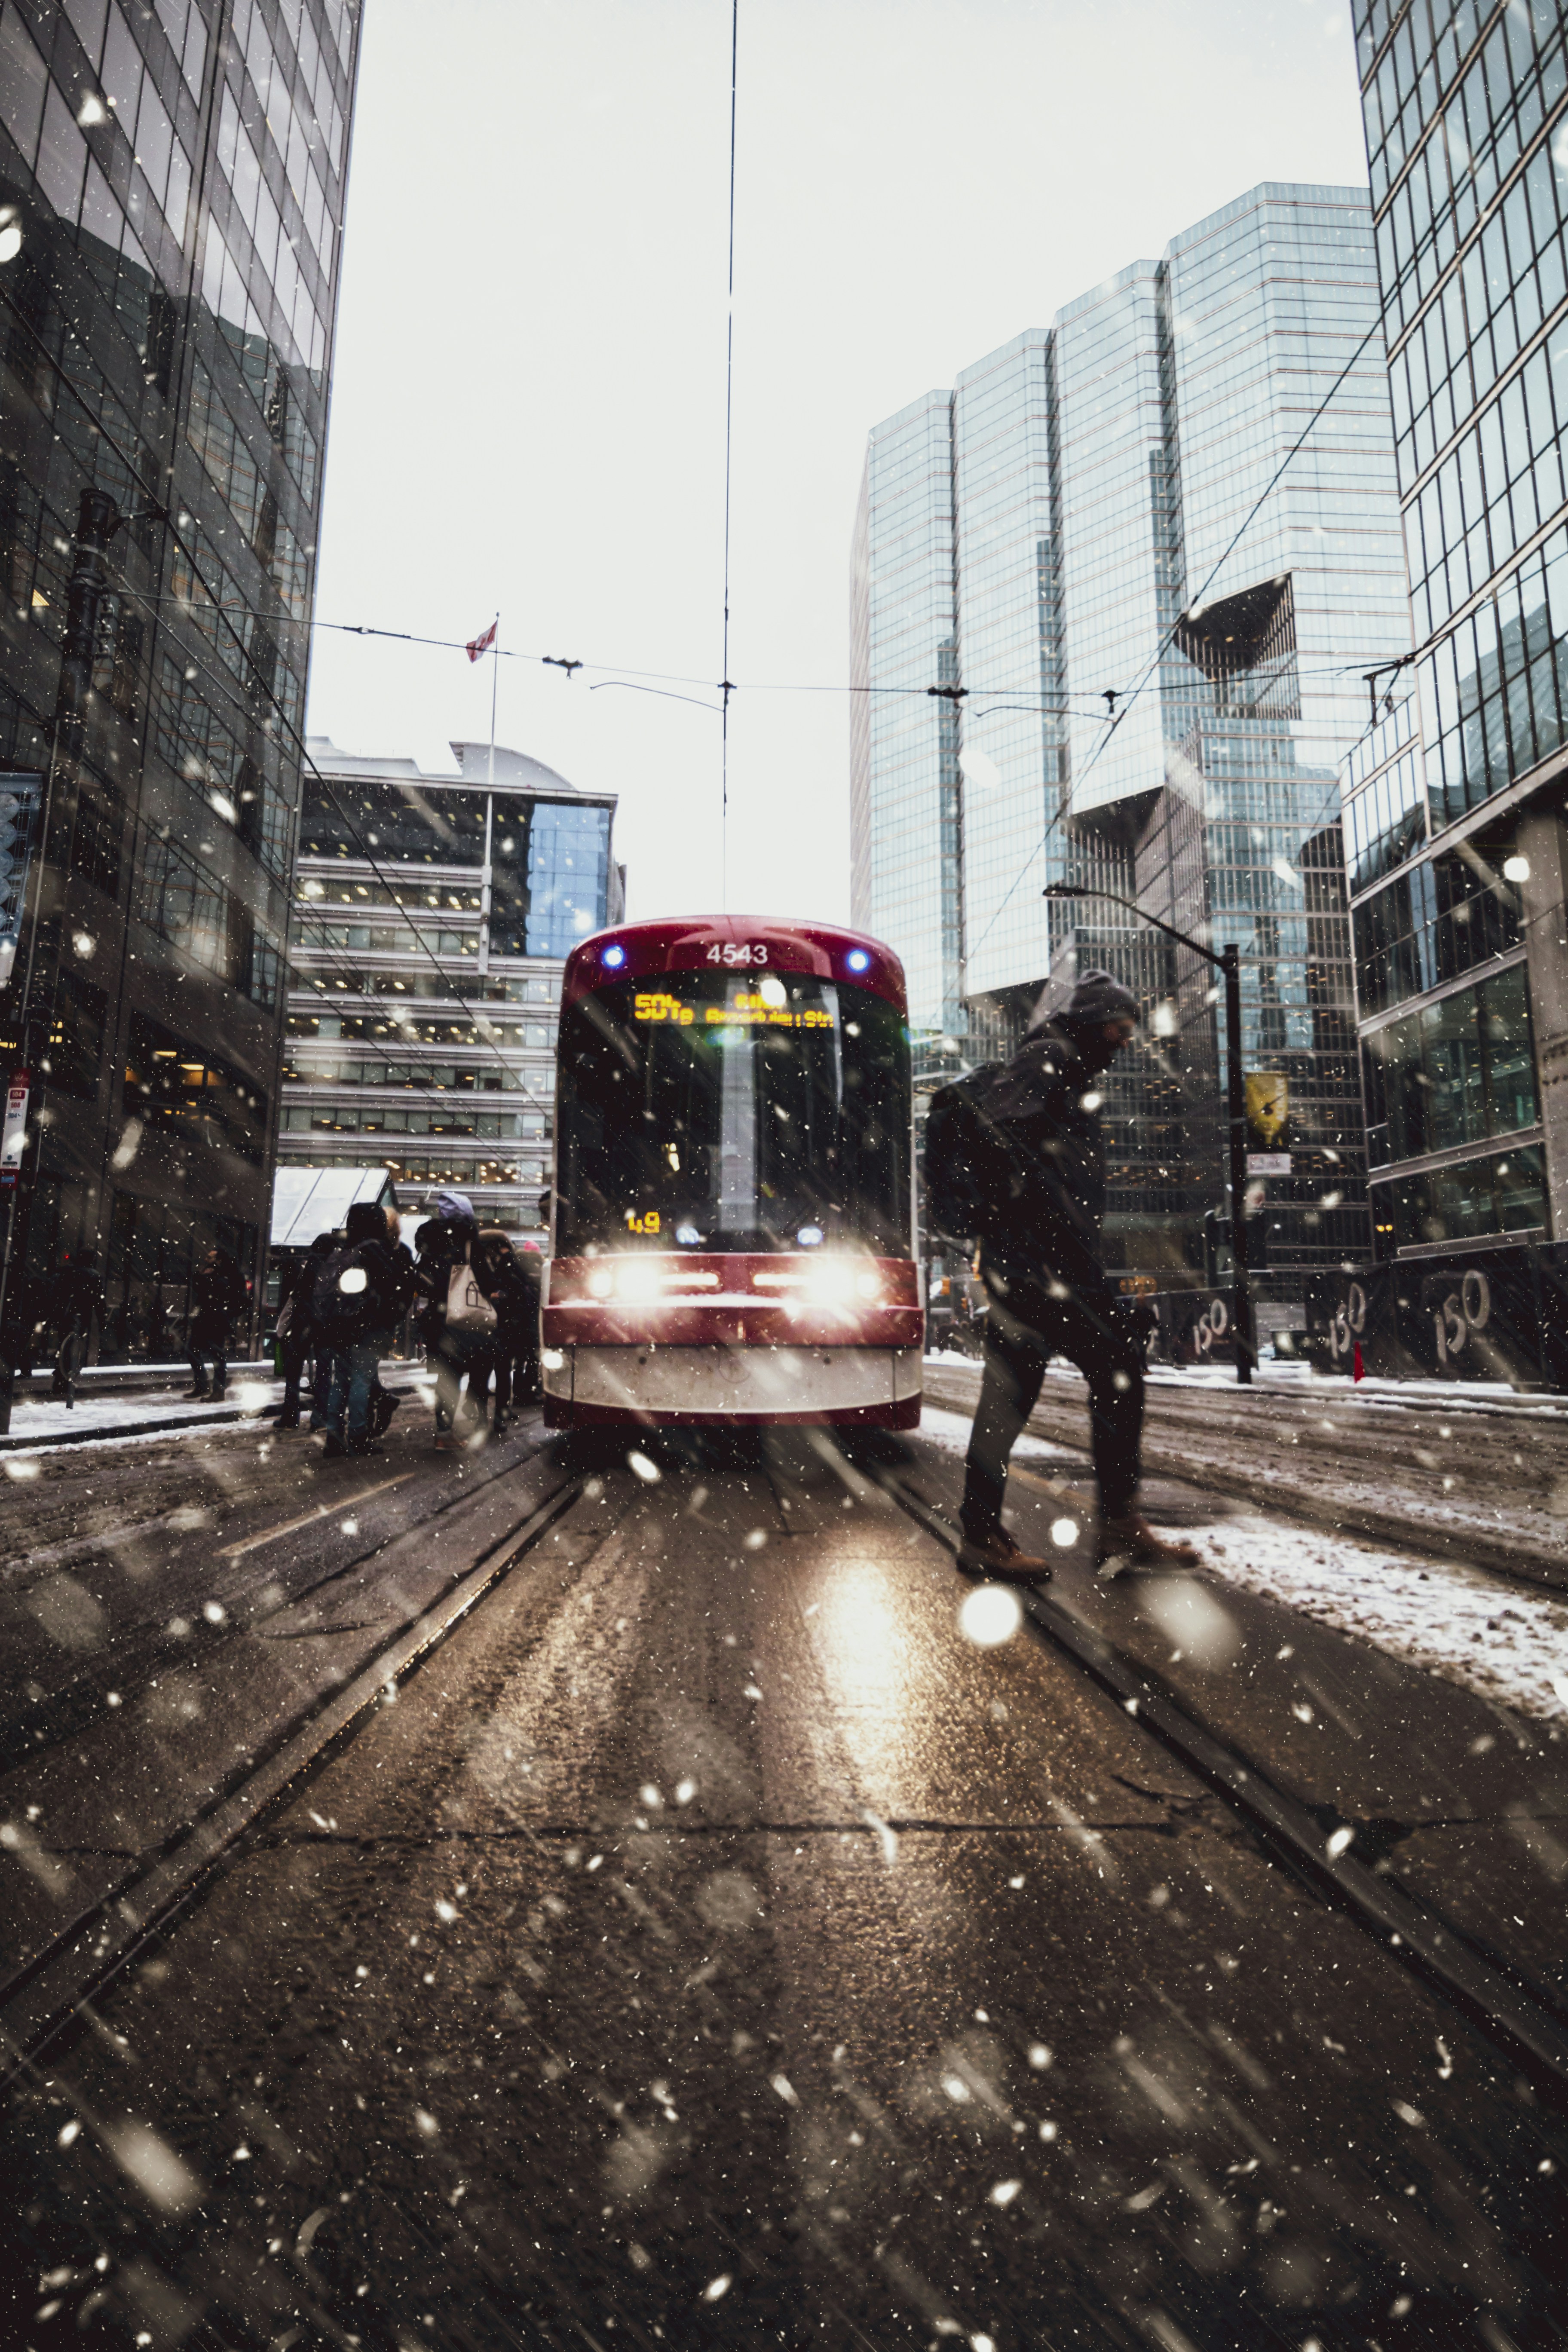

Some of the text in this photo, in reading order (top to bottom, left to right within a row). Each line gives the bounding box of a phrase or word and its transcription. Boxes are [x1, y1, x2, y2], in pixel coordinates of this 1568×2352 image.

[706, 944, 768, 964] 4543
[628, 1212, 660, 1234] 49
[1433, 1269, 1490, 1363] 150
